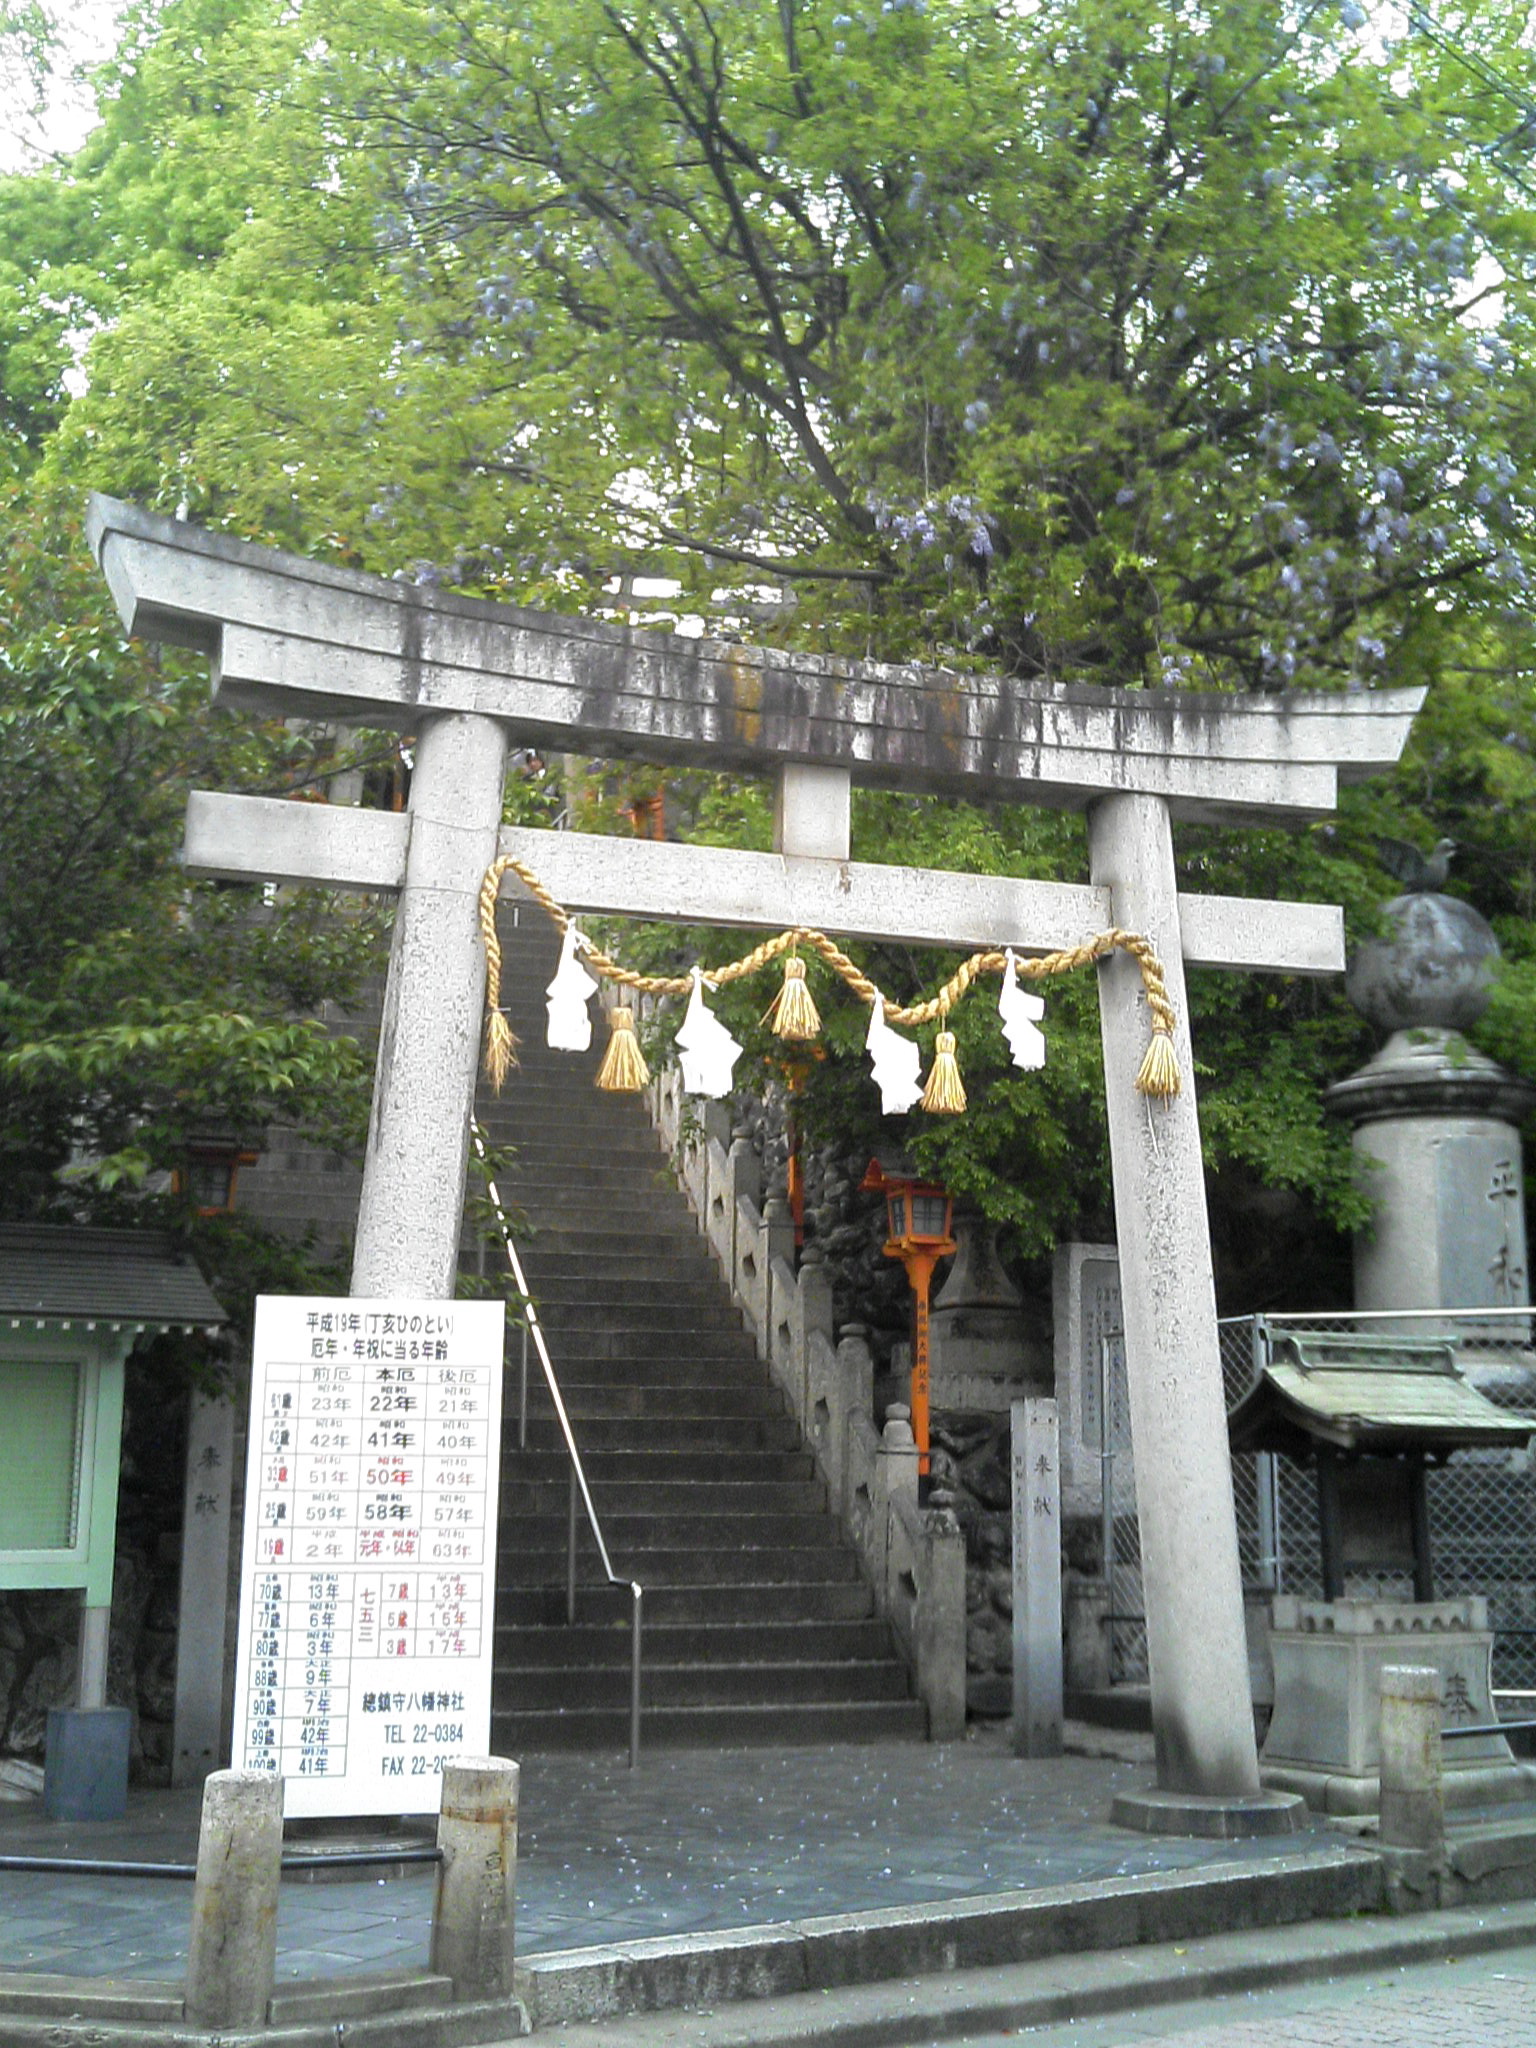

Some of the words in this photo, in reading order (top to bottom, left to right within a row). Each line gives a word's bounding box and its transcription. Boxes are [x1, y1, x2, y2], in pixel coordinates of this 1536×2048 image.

[311, 1338, 448, 1360] 厄年・年祝に当る年齢
[376, 1368, 415, 1382] 本厄
[439, 1369, 477, 1383] 後厄
[311, 1397, 351, 1411] 23年
[370, 1395, 417, 1412] 22年
[439, 1400, 478, 1413] 21年
[310, 1434, 350, 1448] 42年
[367, 1431, 416, 1449] 41年
[437, 1435, 477, 1449] 40年
[309, 1470, 349, 1484] 51年
[366, 1468, 414, 1486] 50年
[436, 1472, 476, 1486] 49年
[306, 1506, 347, 1521] 59年
[364, 1503, 413, 1522] 58年
[434, 1507, 474, 1523] 57年
[306, 1543, 343, 1558] 2年
[429, 1582, 467, 1601] 13年
[258, 1611, 281, 1629] 77歳
[309, 1612, 335, 1630] 6年
[260, 1583, 282, 1600] 70歳
[308, 1583, 340, 1600] 13年
[358, 1588, 376, 1642] 七五三
[256, 1640, 279, 1657] 80歳
[307, 1640, 334, 1658] 3年
[429, 1638, 466, 1657] 17年
[305, 1659, 333, 1668] 大正
[254, 1669, 278, 1687] 88歳
[305, 1669, 333, 1688] 9年
[253, 1698, 276, 1716] 90歳
[304, 1698, 331, 1718] 7年
[251, 1728, 275, 1746] 99歳
[300, 1727, 330, 1746] 42年
[384, 1724, 406, 1743] TEL
[413, 1723, 463, 1743] 22-0384
[299, 1757, 329, 1777] 41年
[382, 1756, 405, 1776] FAX
